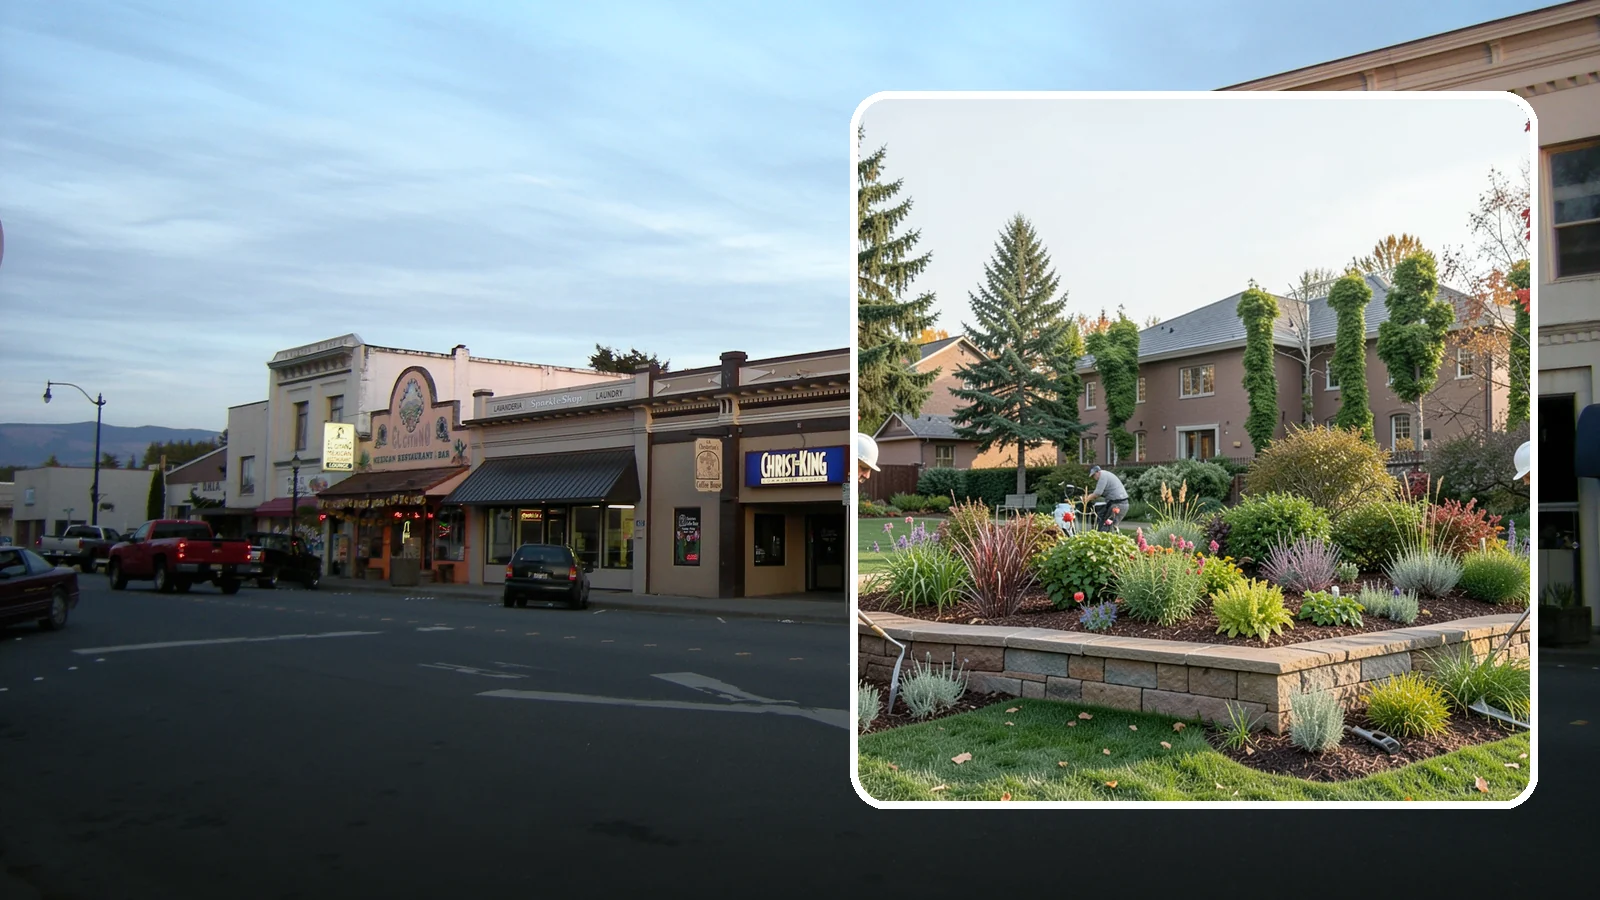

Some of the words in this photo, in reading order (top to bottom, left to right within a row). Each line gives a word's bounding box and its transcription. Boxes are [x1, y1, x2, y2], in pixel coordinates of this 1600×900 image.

[494, 402, 522, 412] LAVANDERIA
[531, 397, 560, 410] Sparkle
[562, 394, 583, 406] Shop
[595, 389, 623, 400] LAUNDRY
[373, 455, 396, 464] MEXICAN
[397, 451, 434, 462] RESTAURANT
[438, 450, 449, 459] BAR
[761, 452, 797, 478] CHRIST
[799, 450, 827, 476] KING
